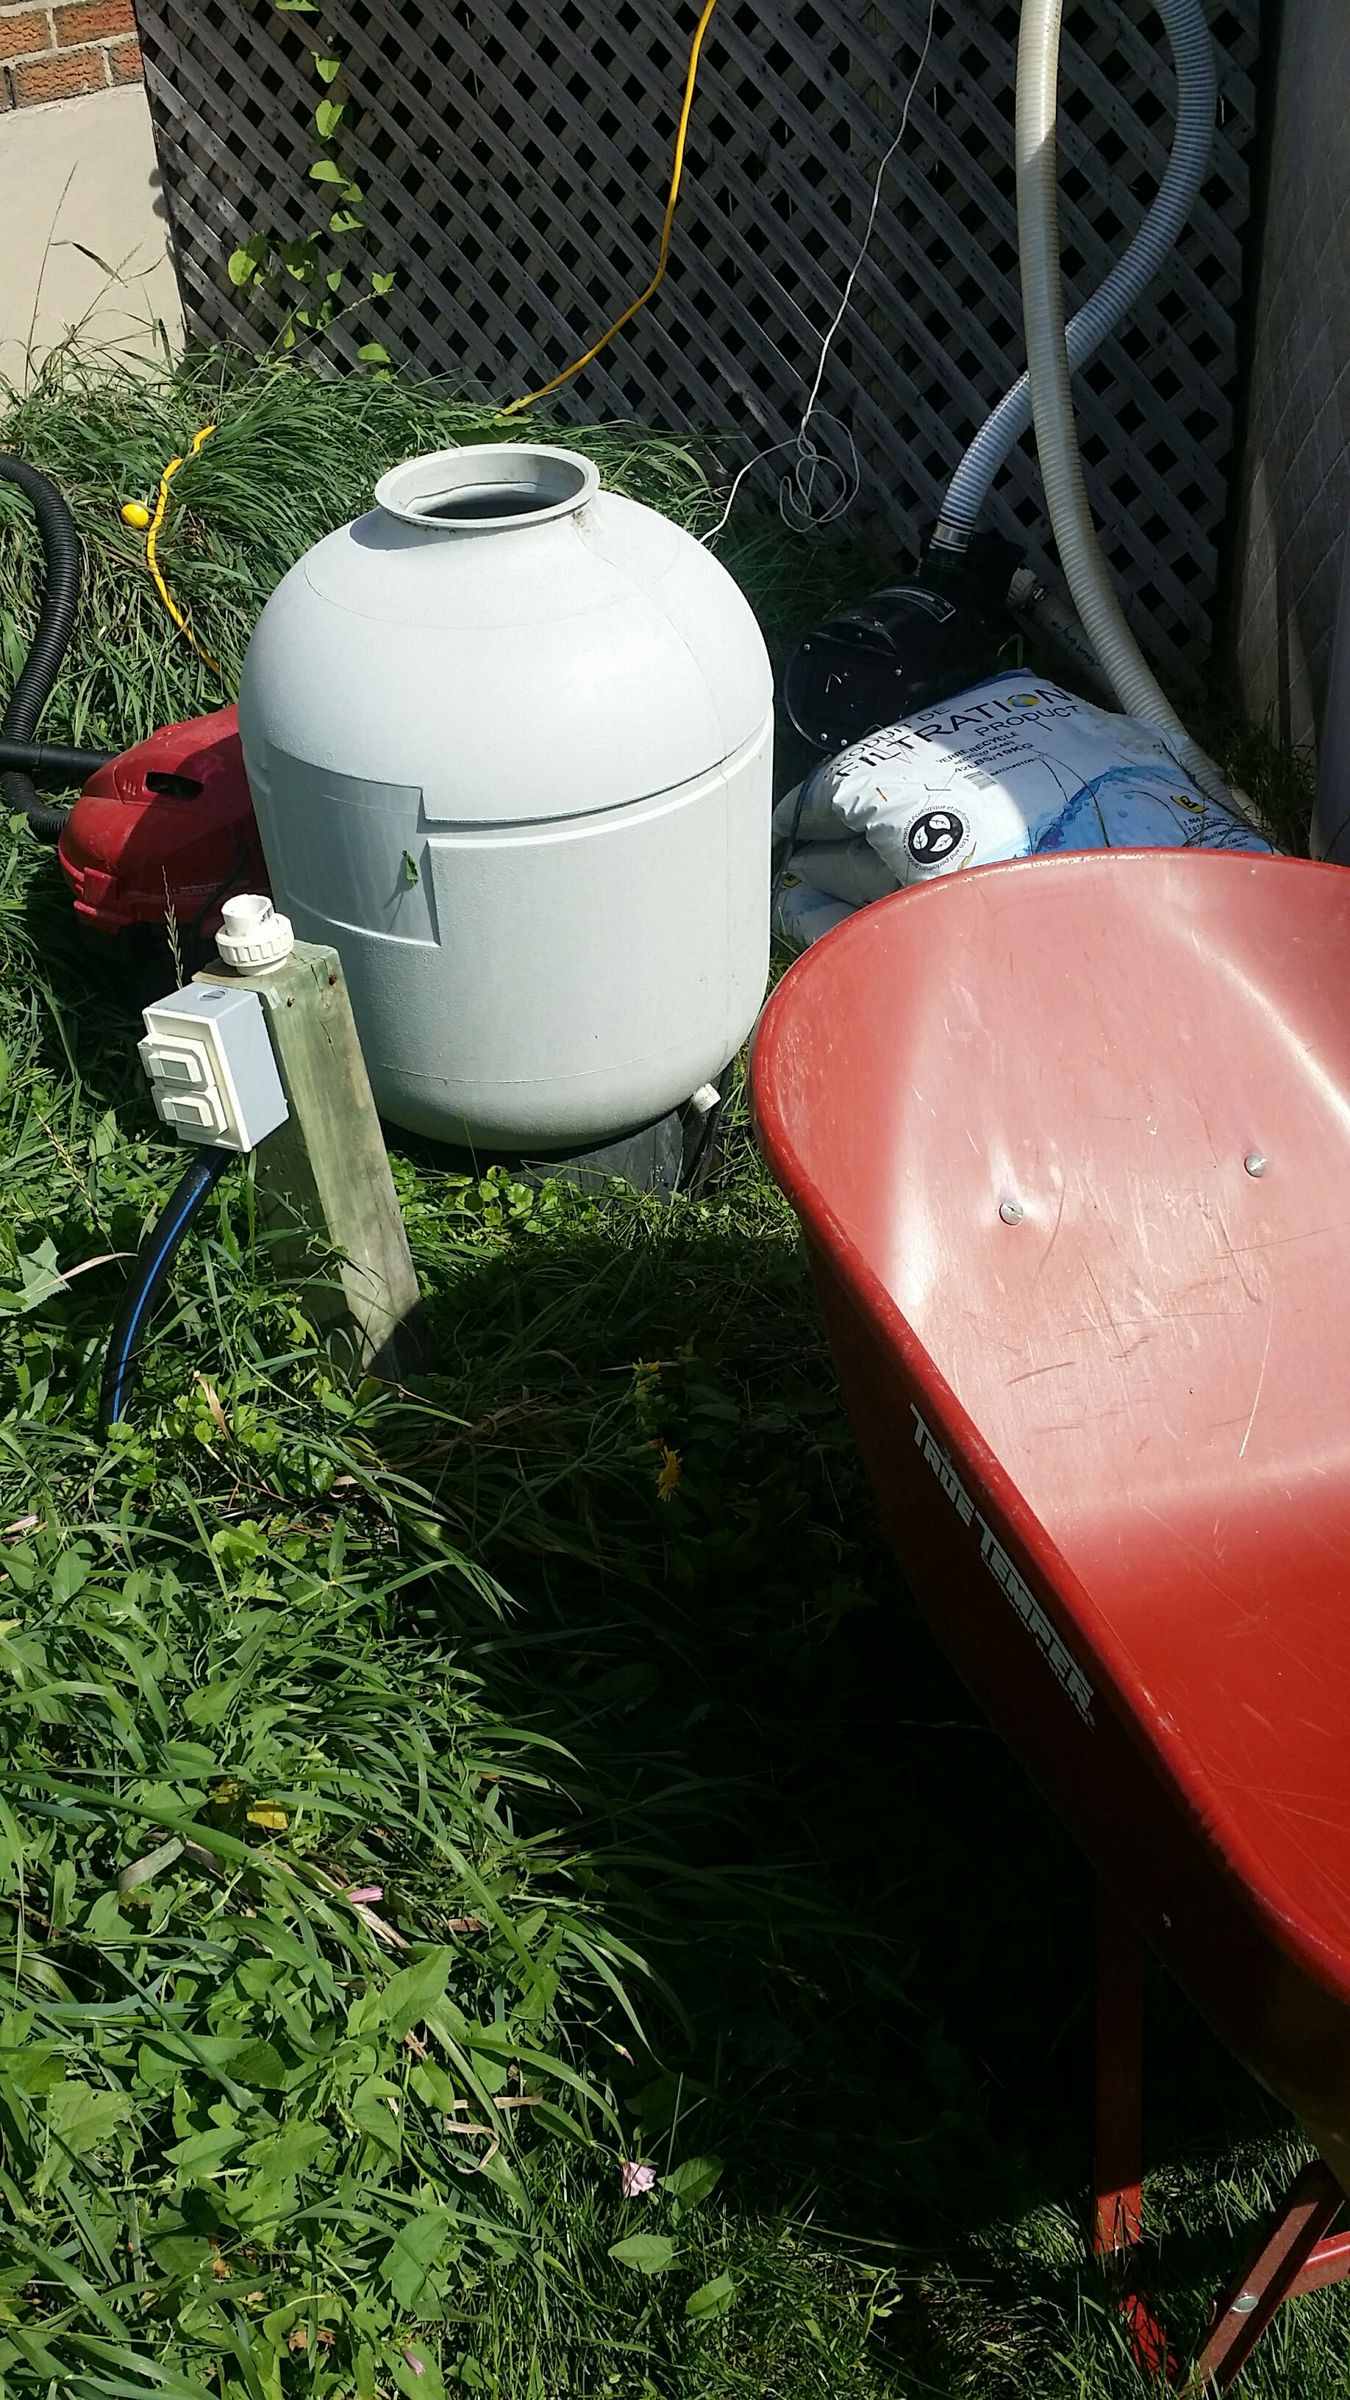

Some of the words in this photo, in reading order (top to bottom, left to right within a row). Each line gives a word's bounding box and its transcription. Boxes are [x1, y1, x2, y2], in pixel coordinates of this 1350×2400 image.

[828, 721, 912, 774] ODUIT
[917, 706, 949, 722] DE
[836, 688, 1073, 777] FILTRATION
[974, 704, 1079, 737] PRODUCT
[910, 1402, 975, 1527] TRUE
[975, 1509, 1094, 1711] TEMPER
